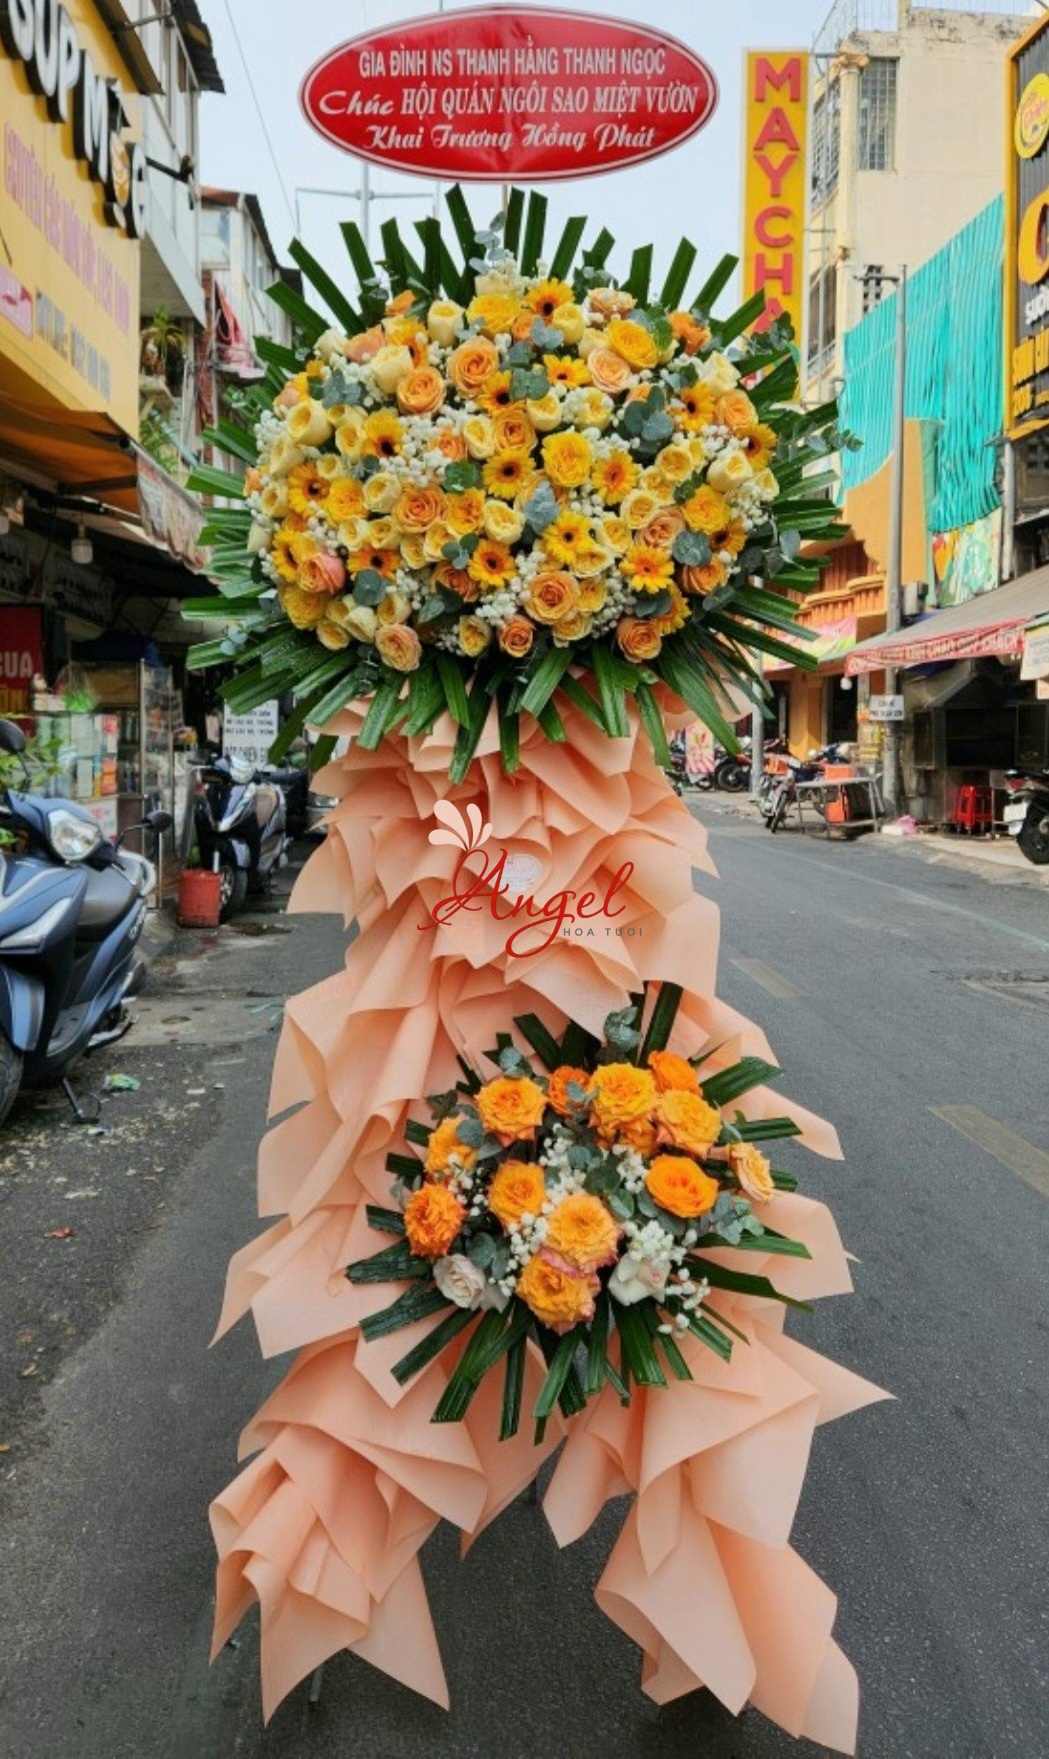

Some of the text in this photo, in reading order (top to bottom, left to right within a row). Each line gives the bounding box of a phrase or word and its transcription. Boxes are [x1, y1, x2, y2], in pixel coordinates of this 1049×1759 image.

[359, 49, 386, 78] GIA
[390, 43, 427, 77] ĐÌNH
[432, 48, 453, 77] NS
[457, 48, 510, 76] THANH
[563, 47, 616, 75] THANH
[620, 48, 666, 80] NGỌC
[318, 79, 699, 120] Chúc HỘI QUÁN NGÔI SAO MIỆT VƯỜN
[362, 122, 656, 152] Khai Trương Hồng Phát
[0, 651, 34, 678] UA
